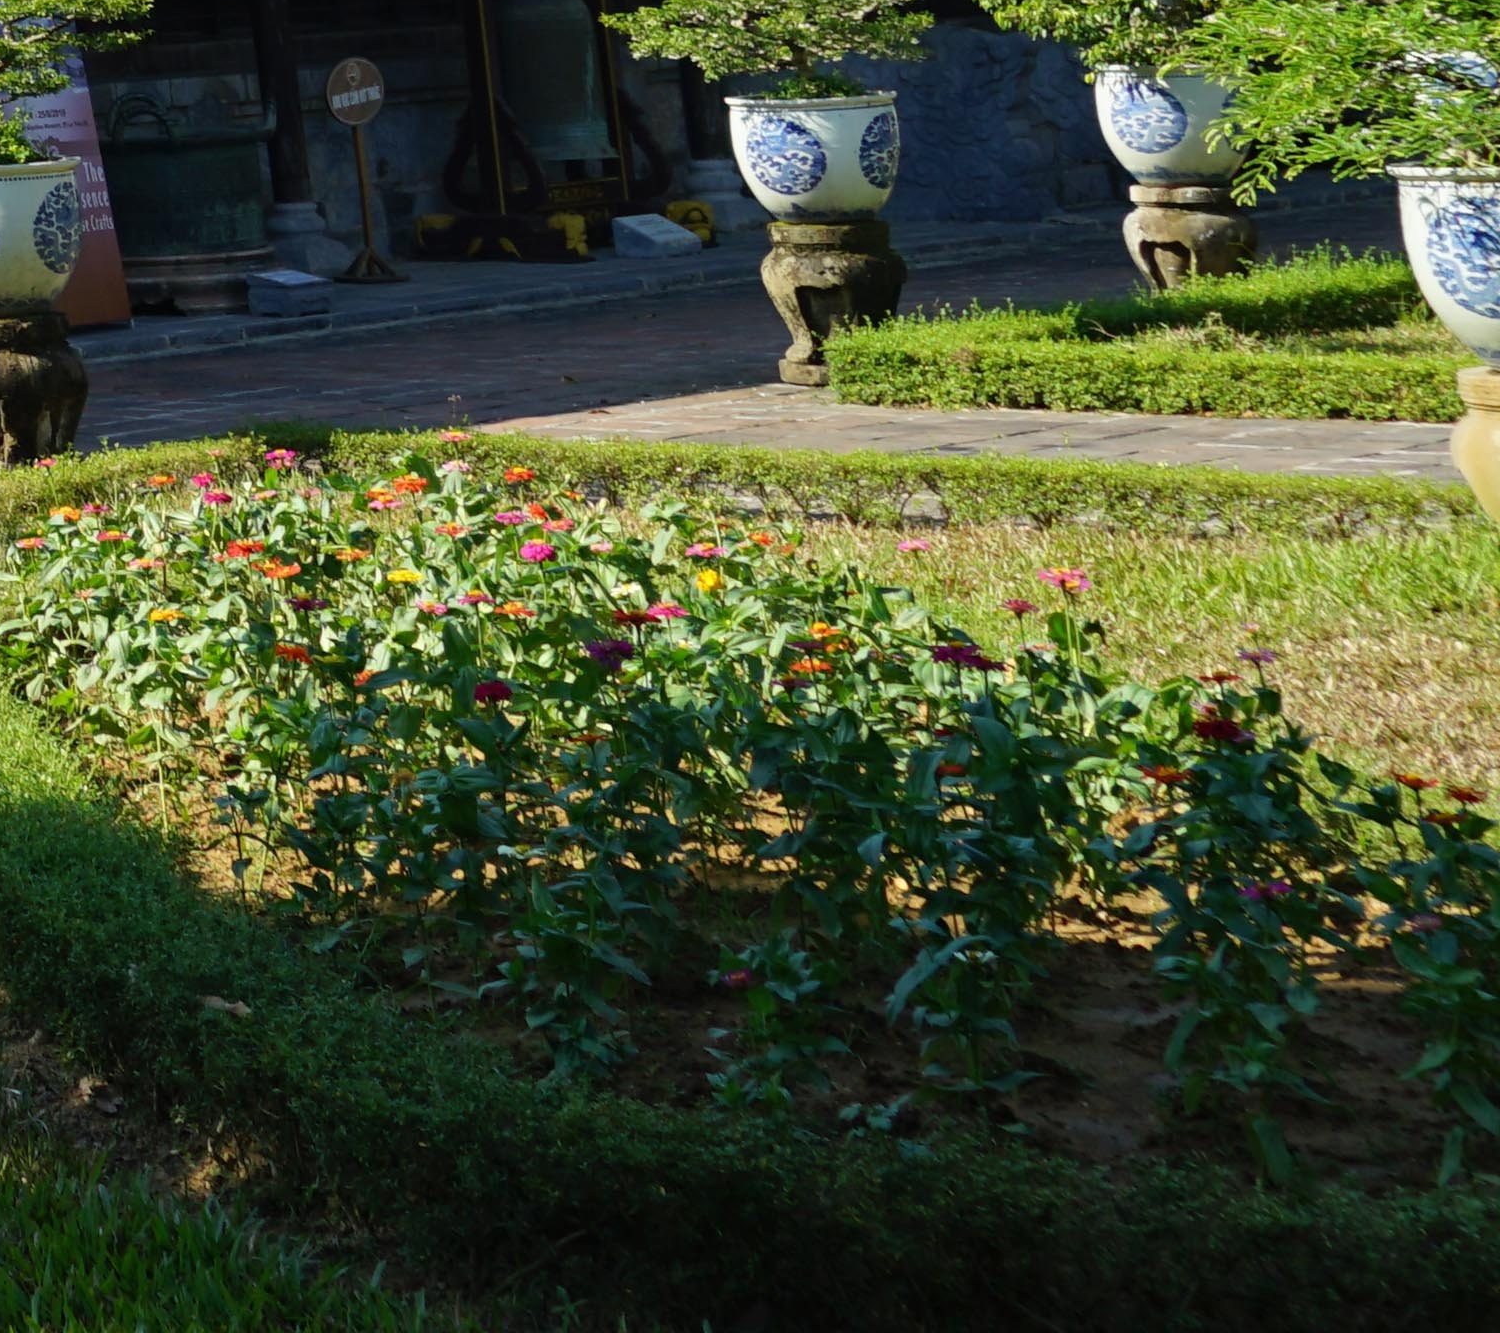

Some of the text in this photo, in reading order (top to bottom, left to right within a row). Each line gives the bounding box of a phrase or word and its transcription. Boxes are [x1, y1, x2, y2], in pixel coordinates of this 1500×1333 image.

[83, 161, 106, 182] The
[81, 192, 110, 209] sence
[90, 214, 115, 231] Crafts
